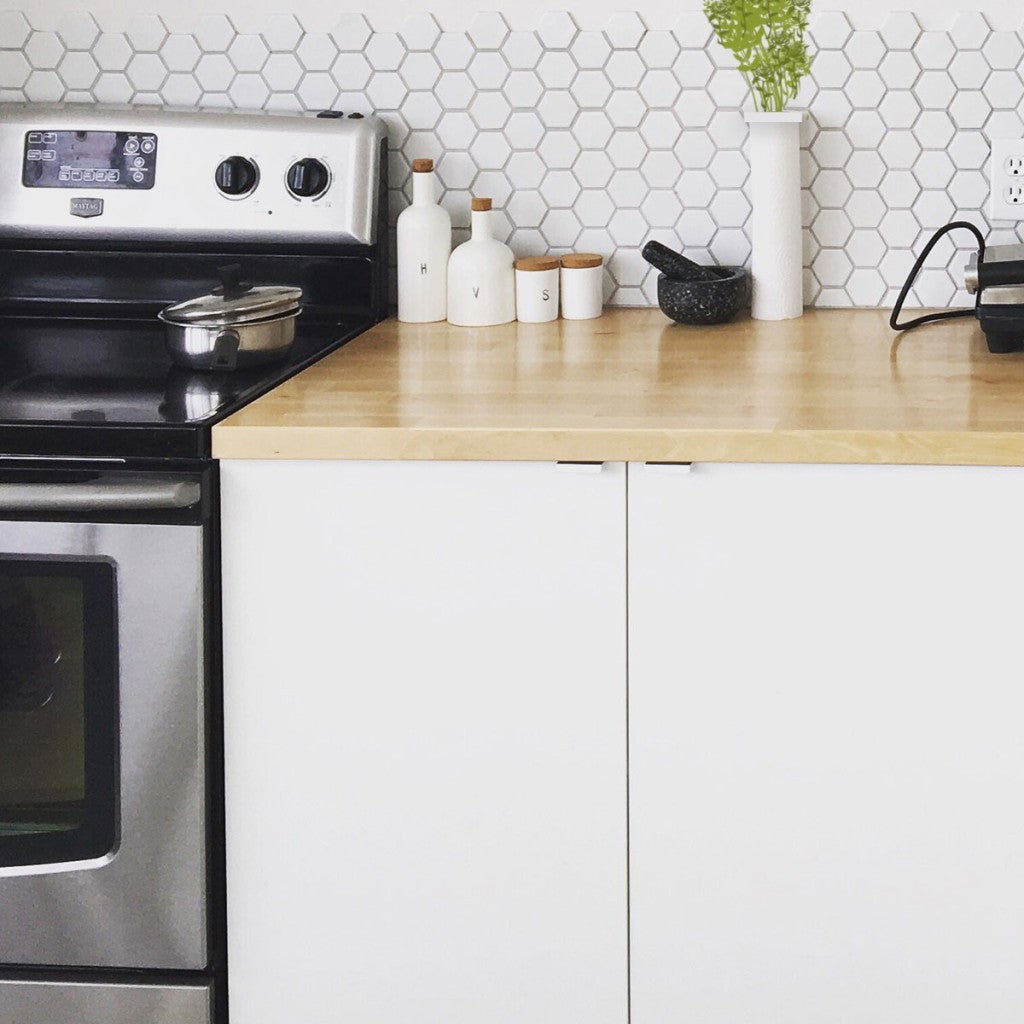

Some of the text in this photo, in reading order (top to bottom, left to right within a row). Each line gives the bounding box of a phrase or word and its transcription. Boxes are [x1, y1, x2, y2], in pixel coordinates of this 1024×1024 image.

[420, 263, 427, 275] H
[473, 287, 480, 299] V
[542, 289, 550, 301] S
